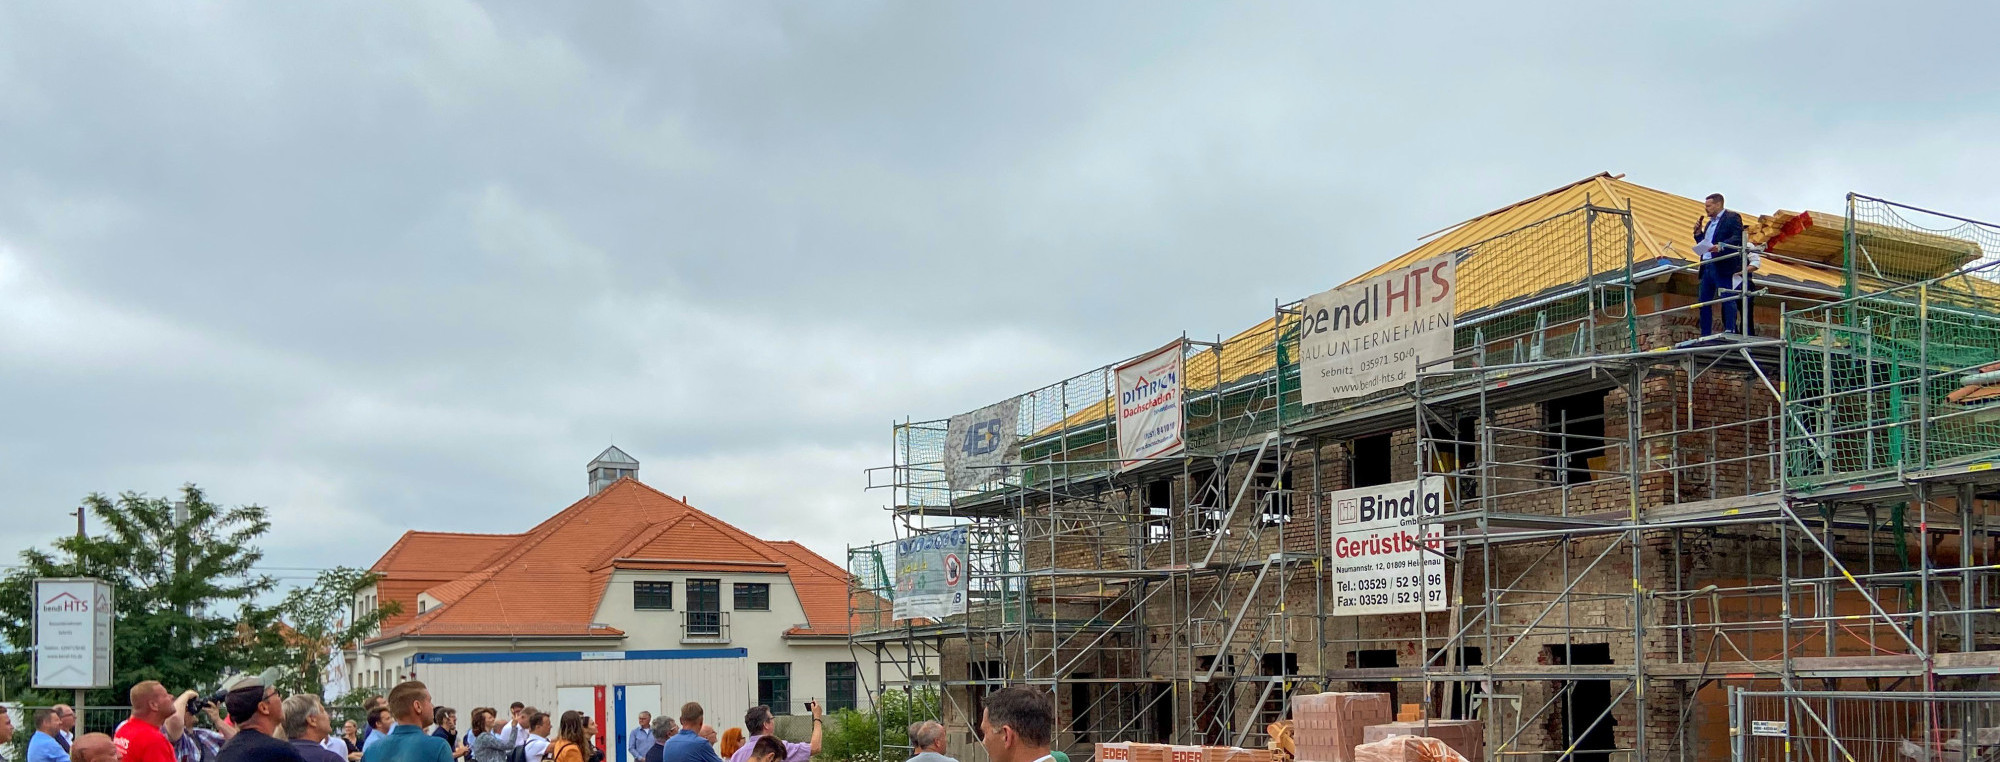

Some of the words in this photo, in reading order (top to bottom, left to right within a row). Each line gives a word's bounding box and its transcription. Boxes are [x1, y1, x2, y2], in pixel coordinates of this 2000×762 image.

[1301, 283, 1379, 340] bendl
[1386, 260, 1450, 318] HTS
[1320, 365, 1353, 378] Sebnitz
[1360, 489, 1440, 523] Bindg
[1400, 518, 1420, 528] Gmb
[1336, 564, 1374, 574] Naumannstr.
[1375, 563, 1386, 571] 12,
[1386, 560, 1406, 570] 01809
[1407, 557, 1441, 569] Heienau
[1336, 580, 1357, 593] Tel.:
[1358, 578, 1387, 591] 03529
[1396, 576, 1409, 588] 52
[1427, 573, 1441, 586] 96
[1337, 596, 1357, 607] Fax:
[1359, 593, 1388, 606] 03529
[1397, 592, 1410, 604] 52
[1428, 590, 1442, 602] 97
[64, 600, 88, 613] HTS
[1102, 747, 1129, 760] EDER
[1172, 751, 1202, 762] EDER
